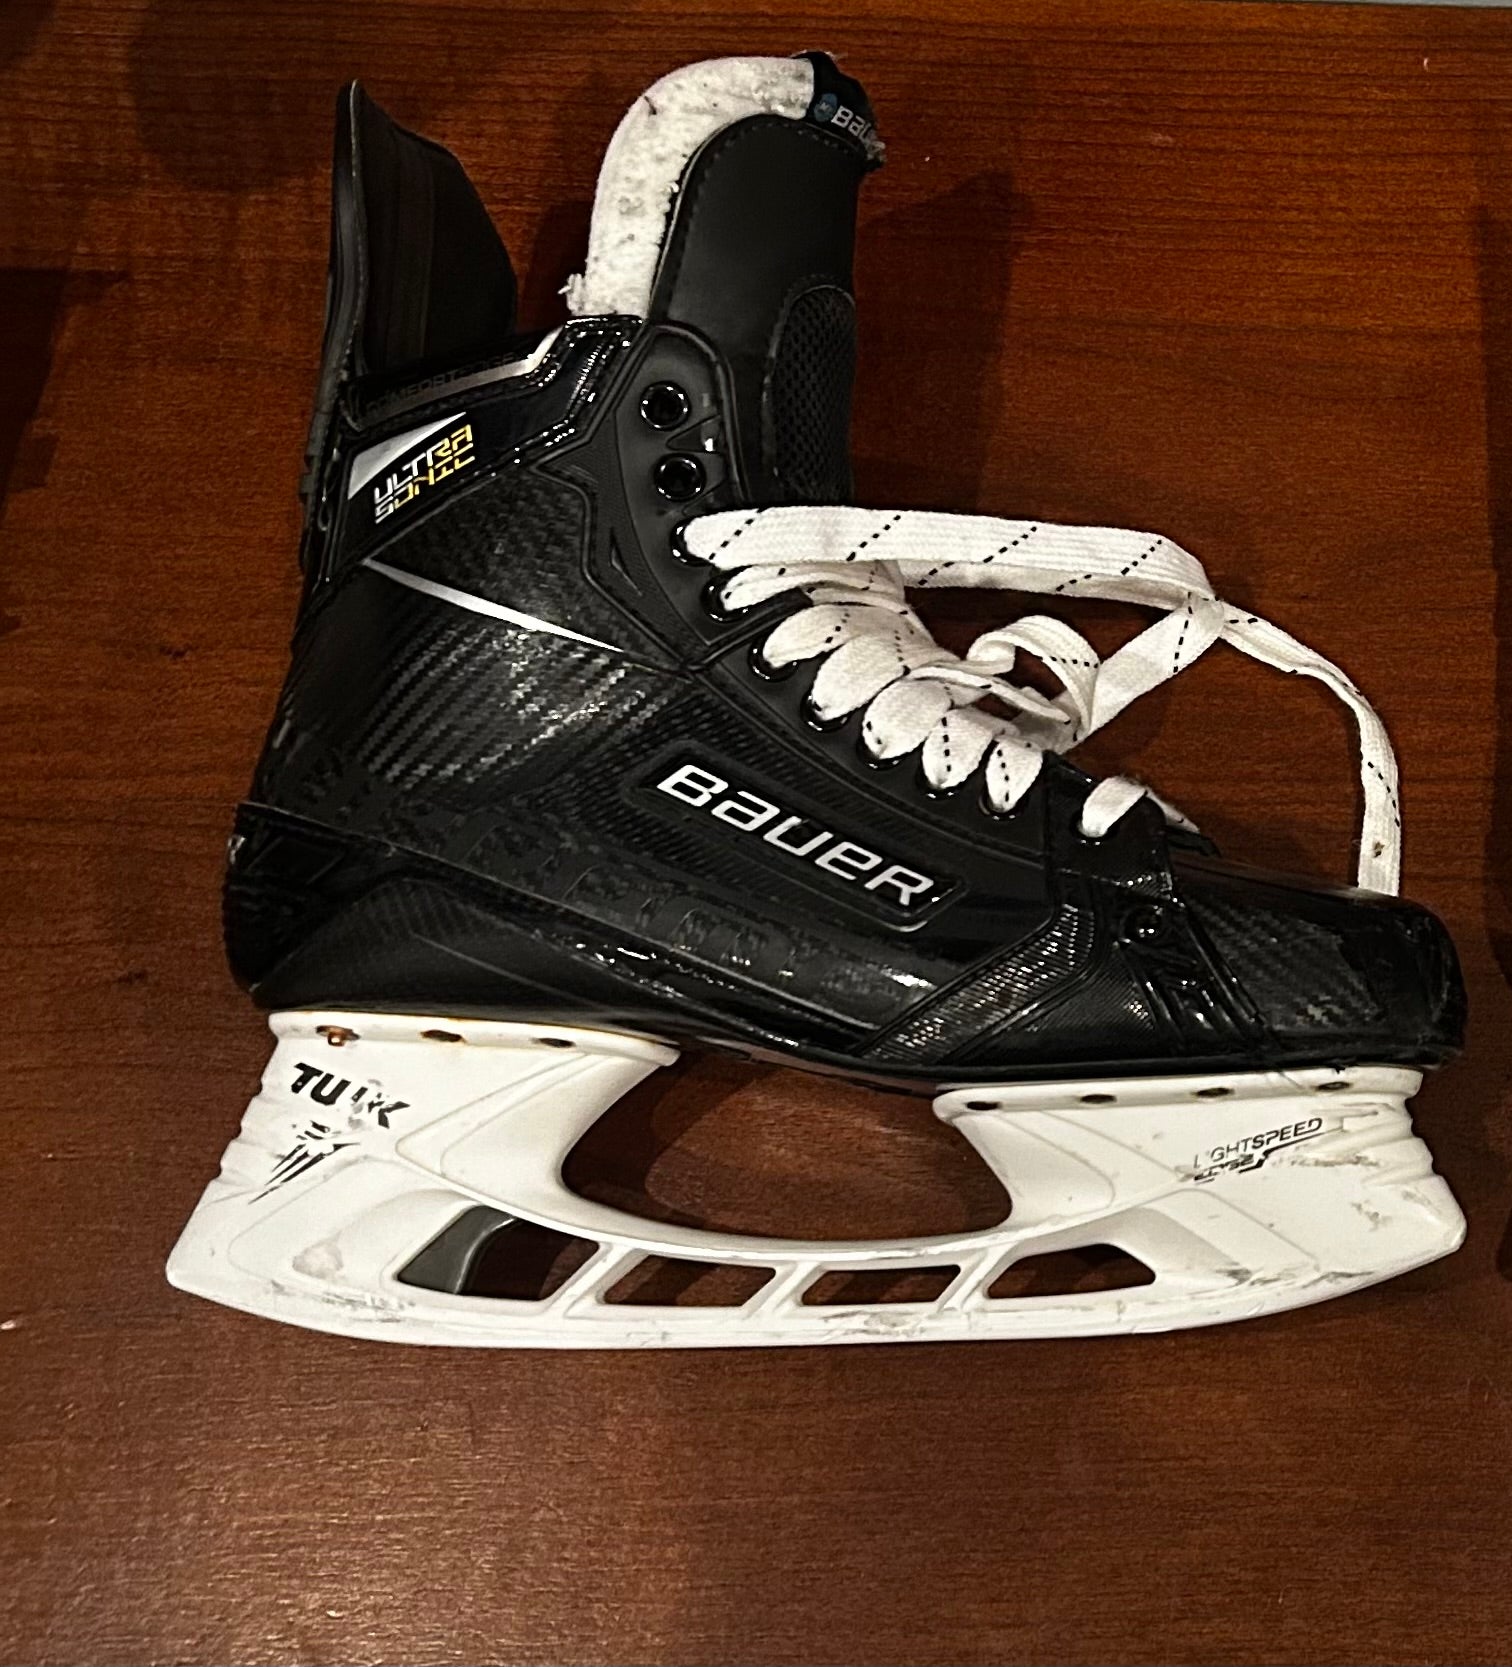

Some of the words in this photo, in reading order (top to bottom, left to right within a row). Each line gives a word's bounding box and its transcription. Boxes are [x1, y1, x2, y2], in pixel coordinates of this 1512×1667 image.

[373, 423, 473, 504] ULTRA
[374, 443, 475, 524] SONIC
[656, 764, 934, 906] BAUER
[1193, 1117, 1323, 1168] LGHTSPEED
